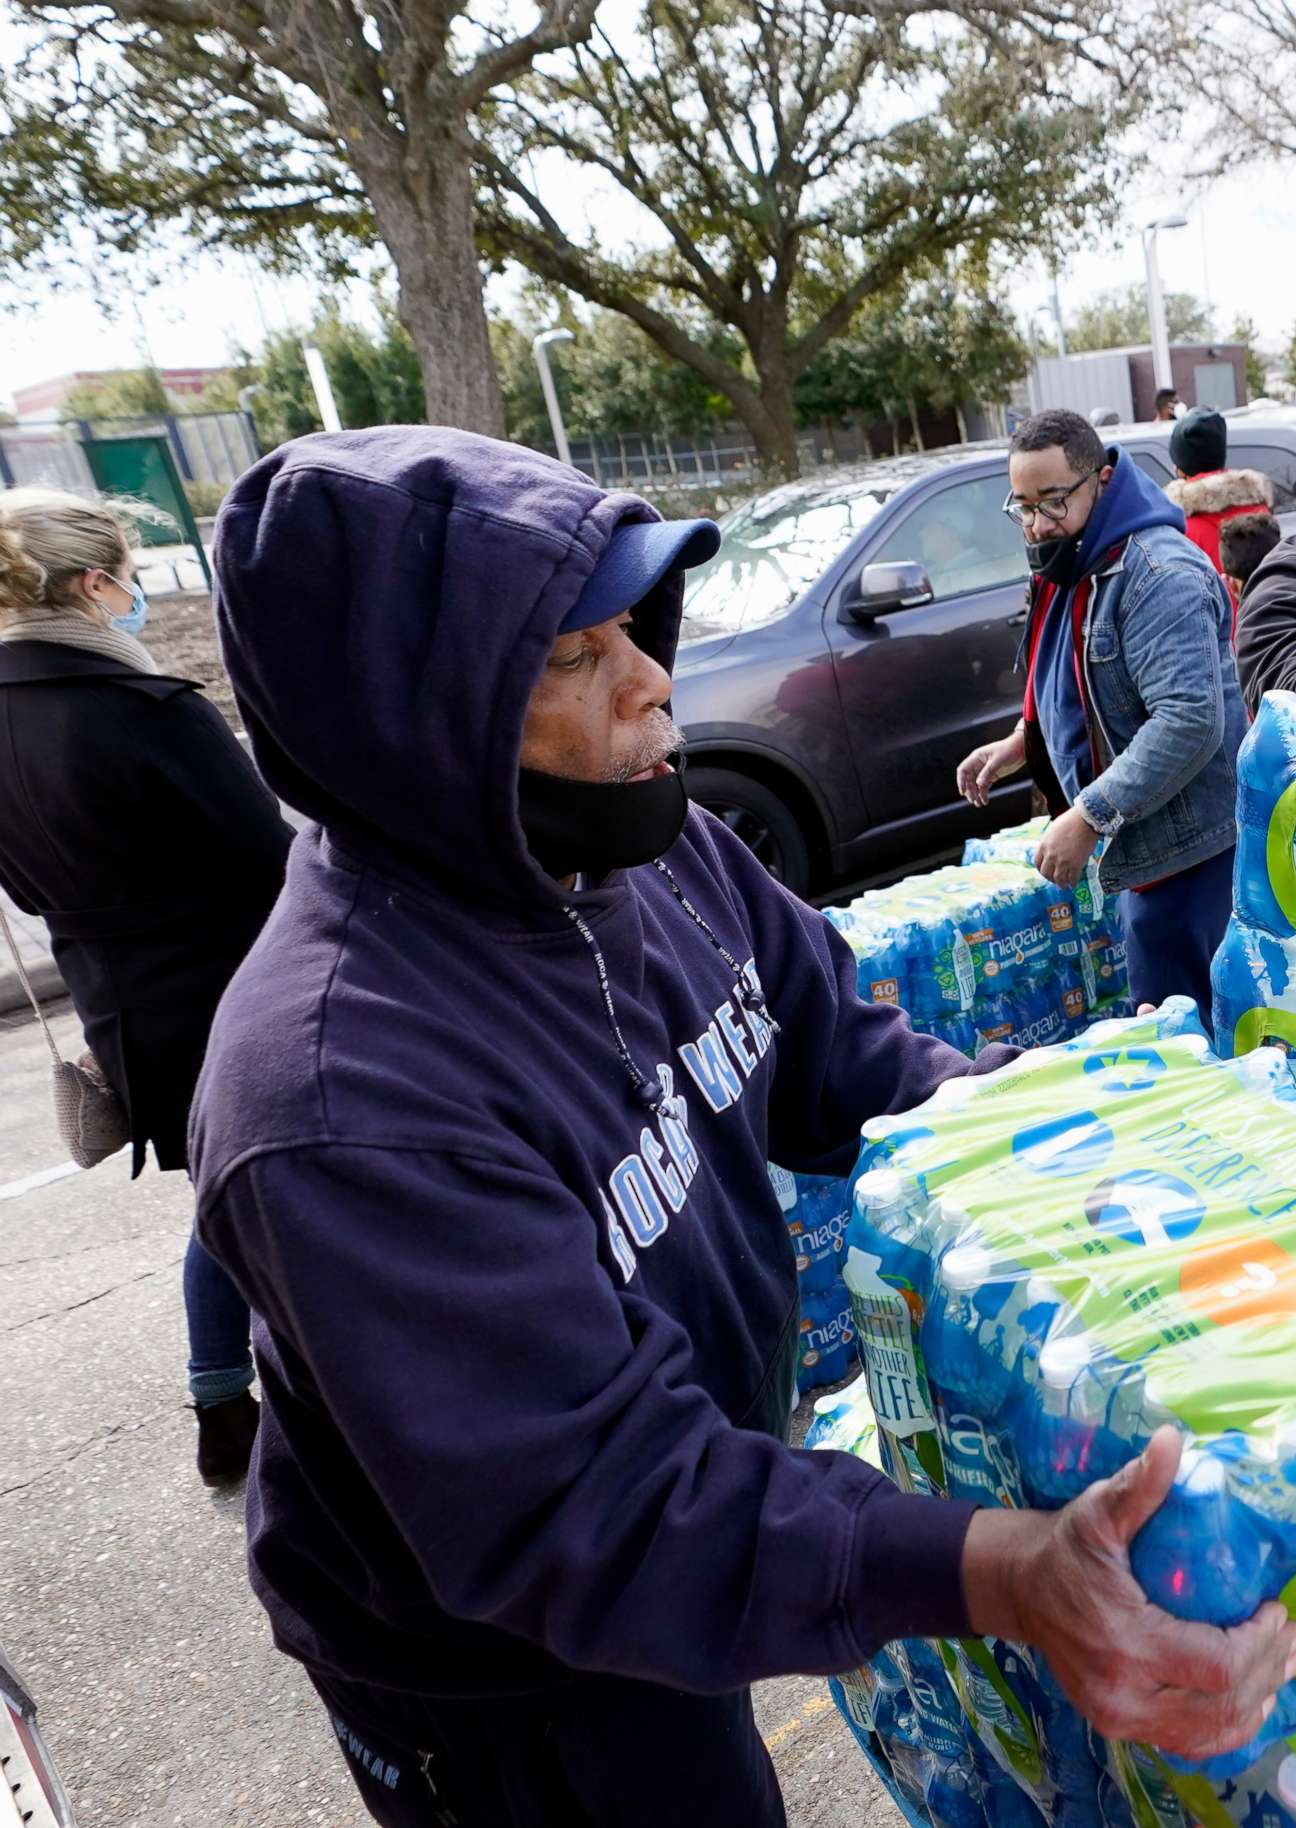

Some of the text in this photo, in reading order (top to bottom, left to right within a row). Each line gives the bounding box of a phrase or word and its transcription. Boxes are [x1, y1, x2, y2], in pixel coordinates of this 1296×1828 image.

[989, 922, 1047, 966] niagara
[873, 981, 896, 997] 40
[1065, 991, 1083, 1005] 40
